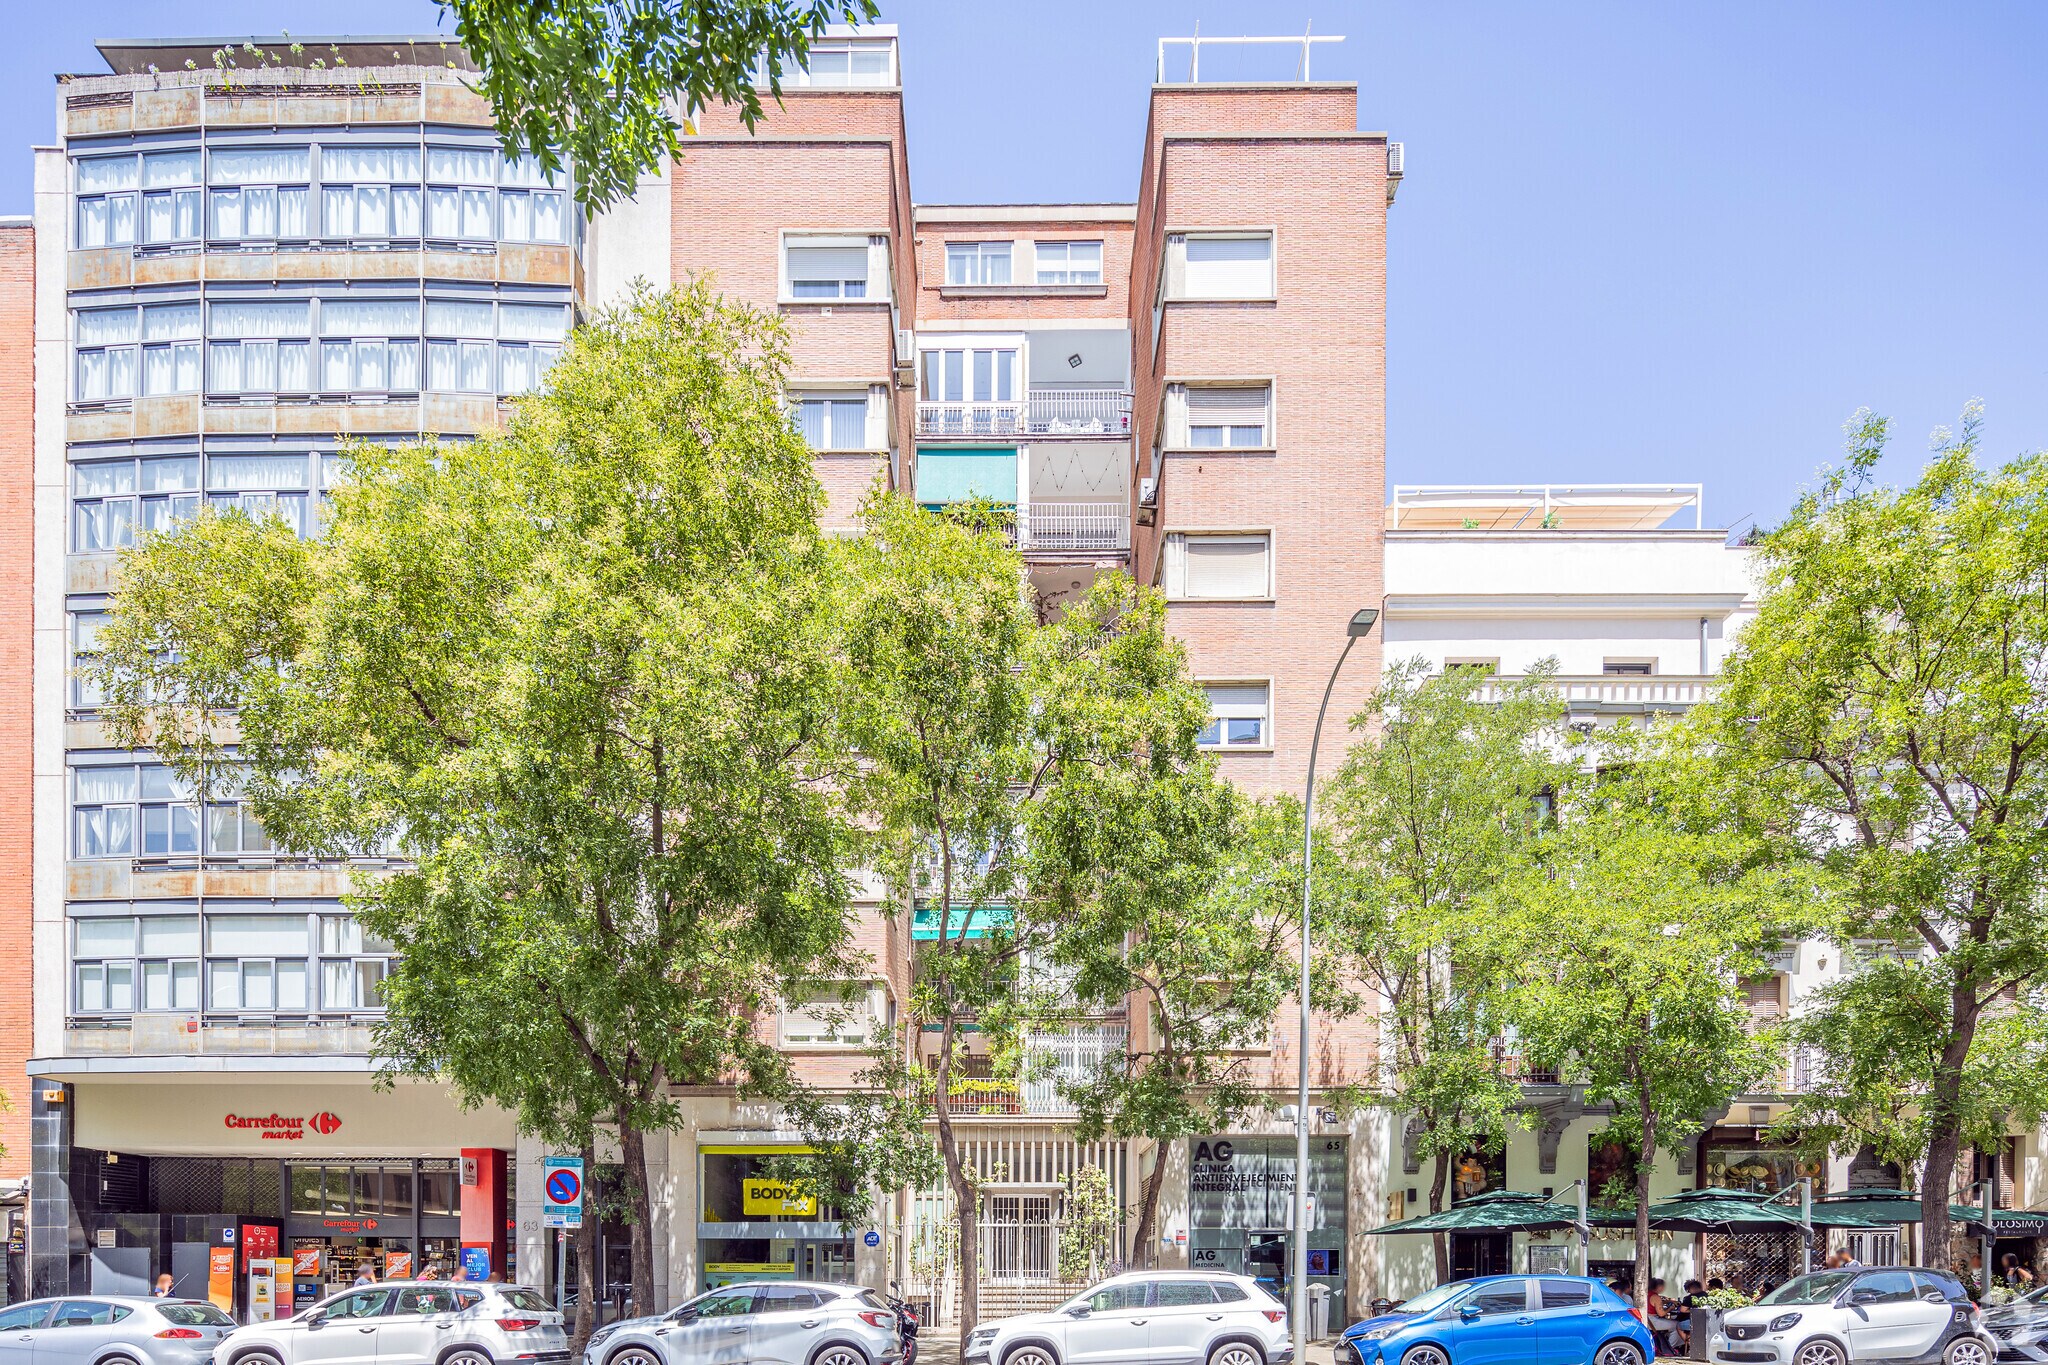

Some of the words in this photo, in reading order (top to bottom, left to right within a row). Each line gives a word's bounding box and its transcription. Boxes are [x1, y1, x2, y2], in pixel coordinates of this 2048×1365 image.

[224, 1113, 304, 1128] Carrefour
[262, 1130, 304, 1140] market
[1326, 1141, 1340, 1150] 65
[1194, 1141, 1234, 1161] AG
[1194, 1174, 1297, 1182] ANTIENVEJECIMIEN
[1193, 1183, 1246, 1191] INTEGRAL
[751, 1188, 793, 1199] BODY
[782, 1199, 808, 1212] FIX
[523, 1221, 538, 1231] 63
[1991, 1220, 2044, 1233] OLOSIMO
[1195, 1251, 1216, 1261] AG
